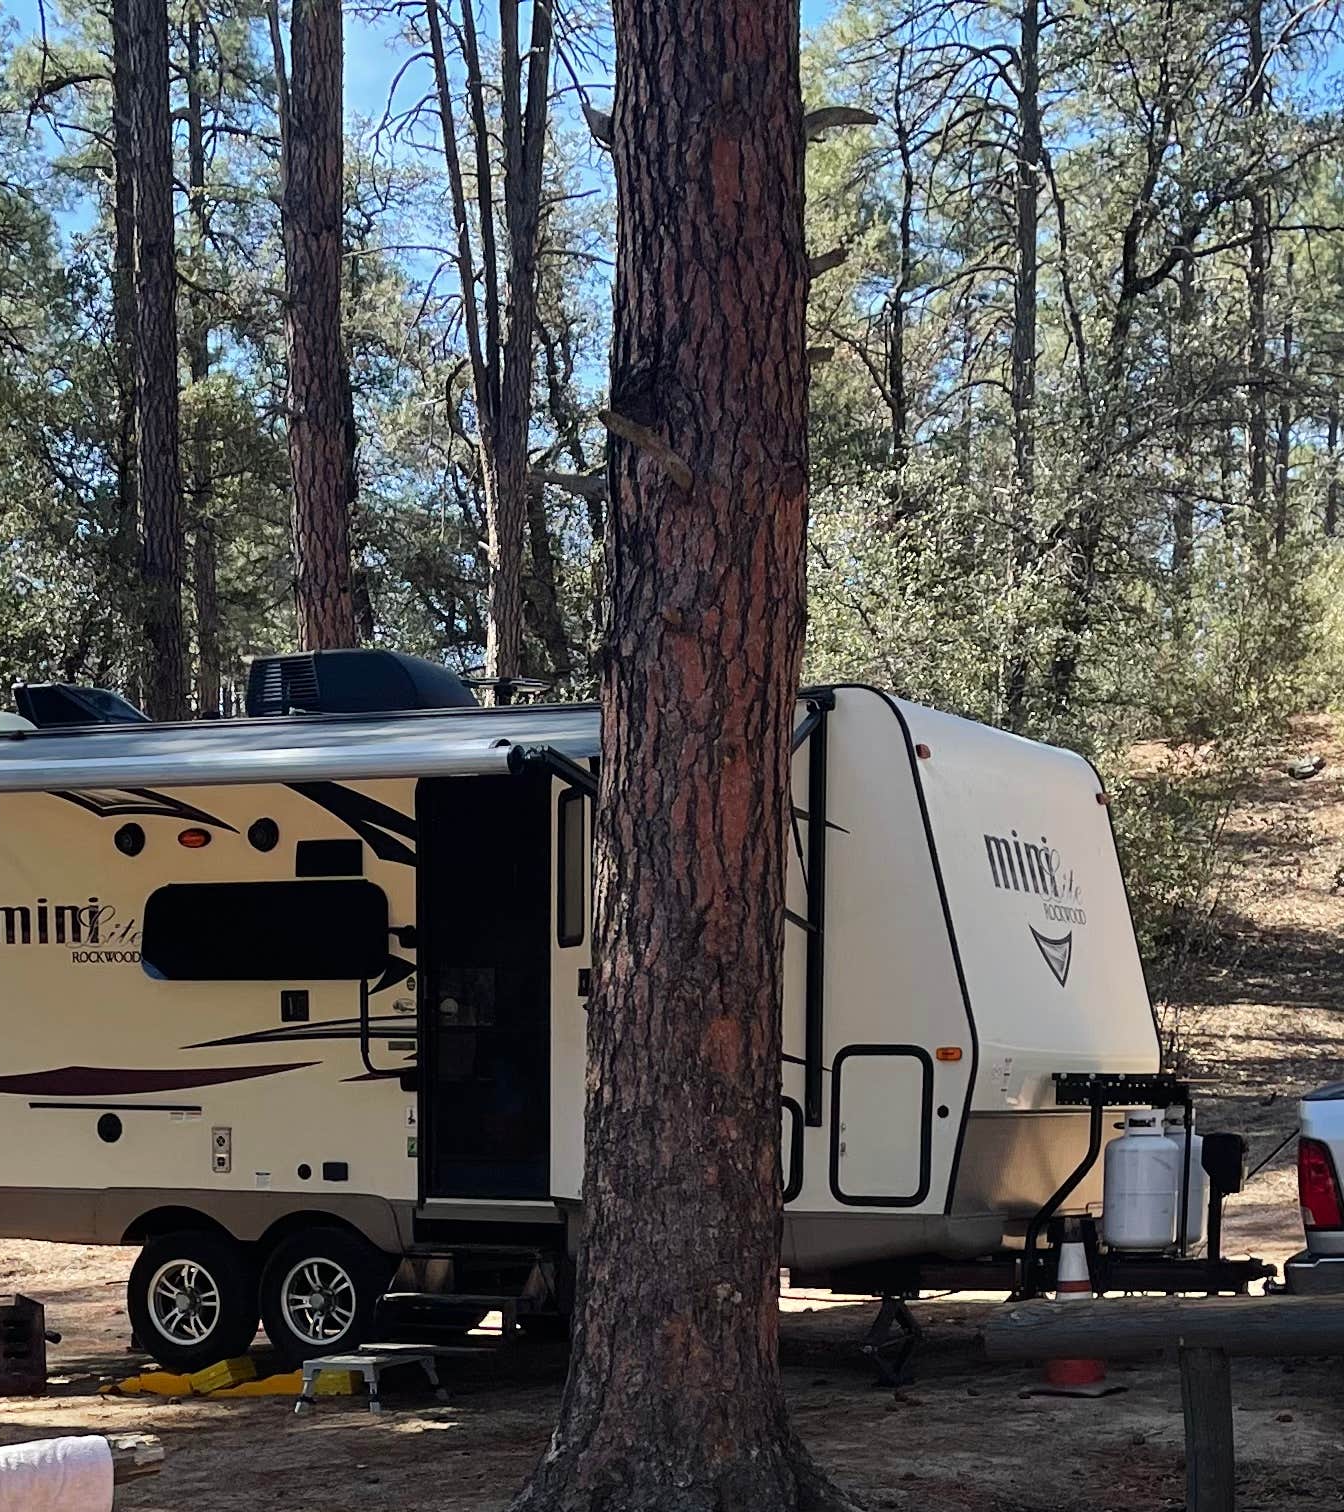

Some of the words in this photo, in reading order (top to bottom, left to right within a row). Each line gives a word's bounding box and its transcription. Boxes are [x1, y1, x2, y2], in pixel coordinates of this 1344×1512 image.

[983, 829, 1059, 897] mini
[65, 905, 143, 949] Lite
[72, 951, 141, 963] ROCKWOOD
